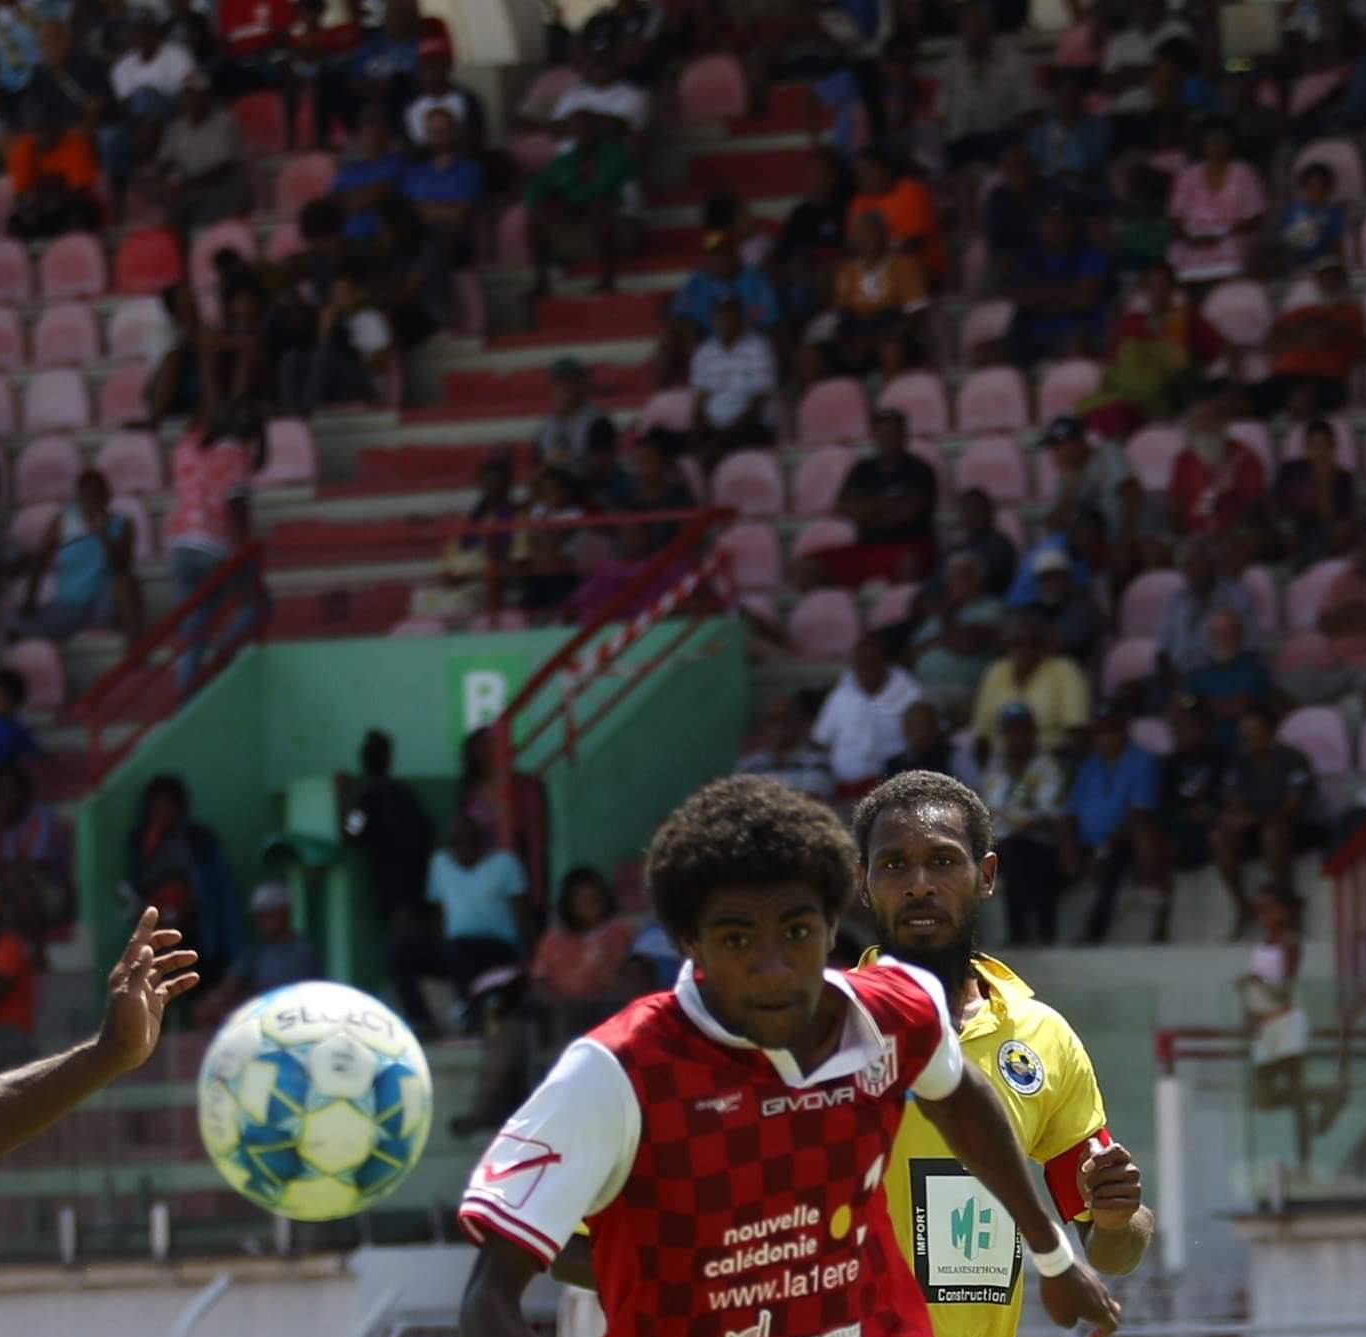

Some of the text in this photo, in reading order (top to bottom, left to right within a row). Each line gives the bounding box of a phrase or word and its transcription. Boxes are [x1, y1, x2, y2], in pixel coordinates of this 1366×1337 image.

[762, 1086, 855, 1117] GIVOVA
[723, 1203, 821, 1246] nouvelle
[916, 1205, 927, 1256] IMPORT
[703, 1234, 819, 1279] calédonie
[938, 1288, 1007, 1303] Construction
